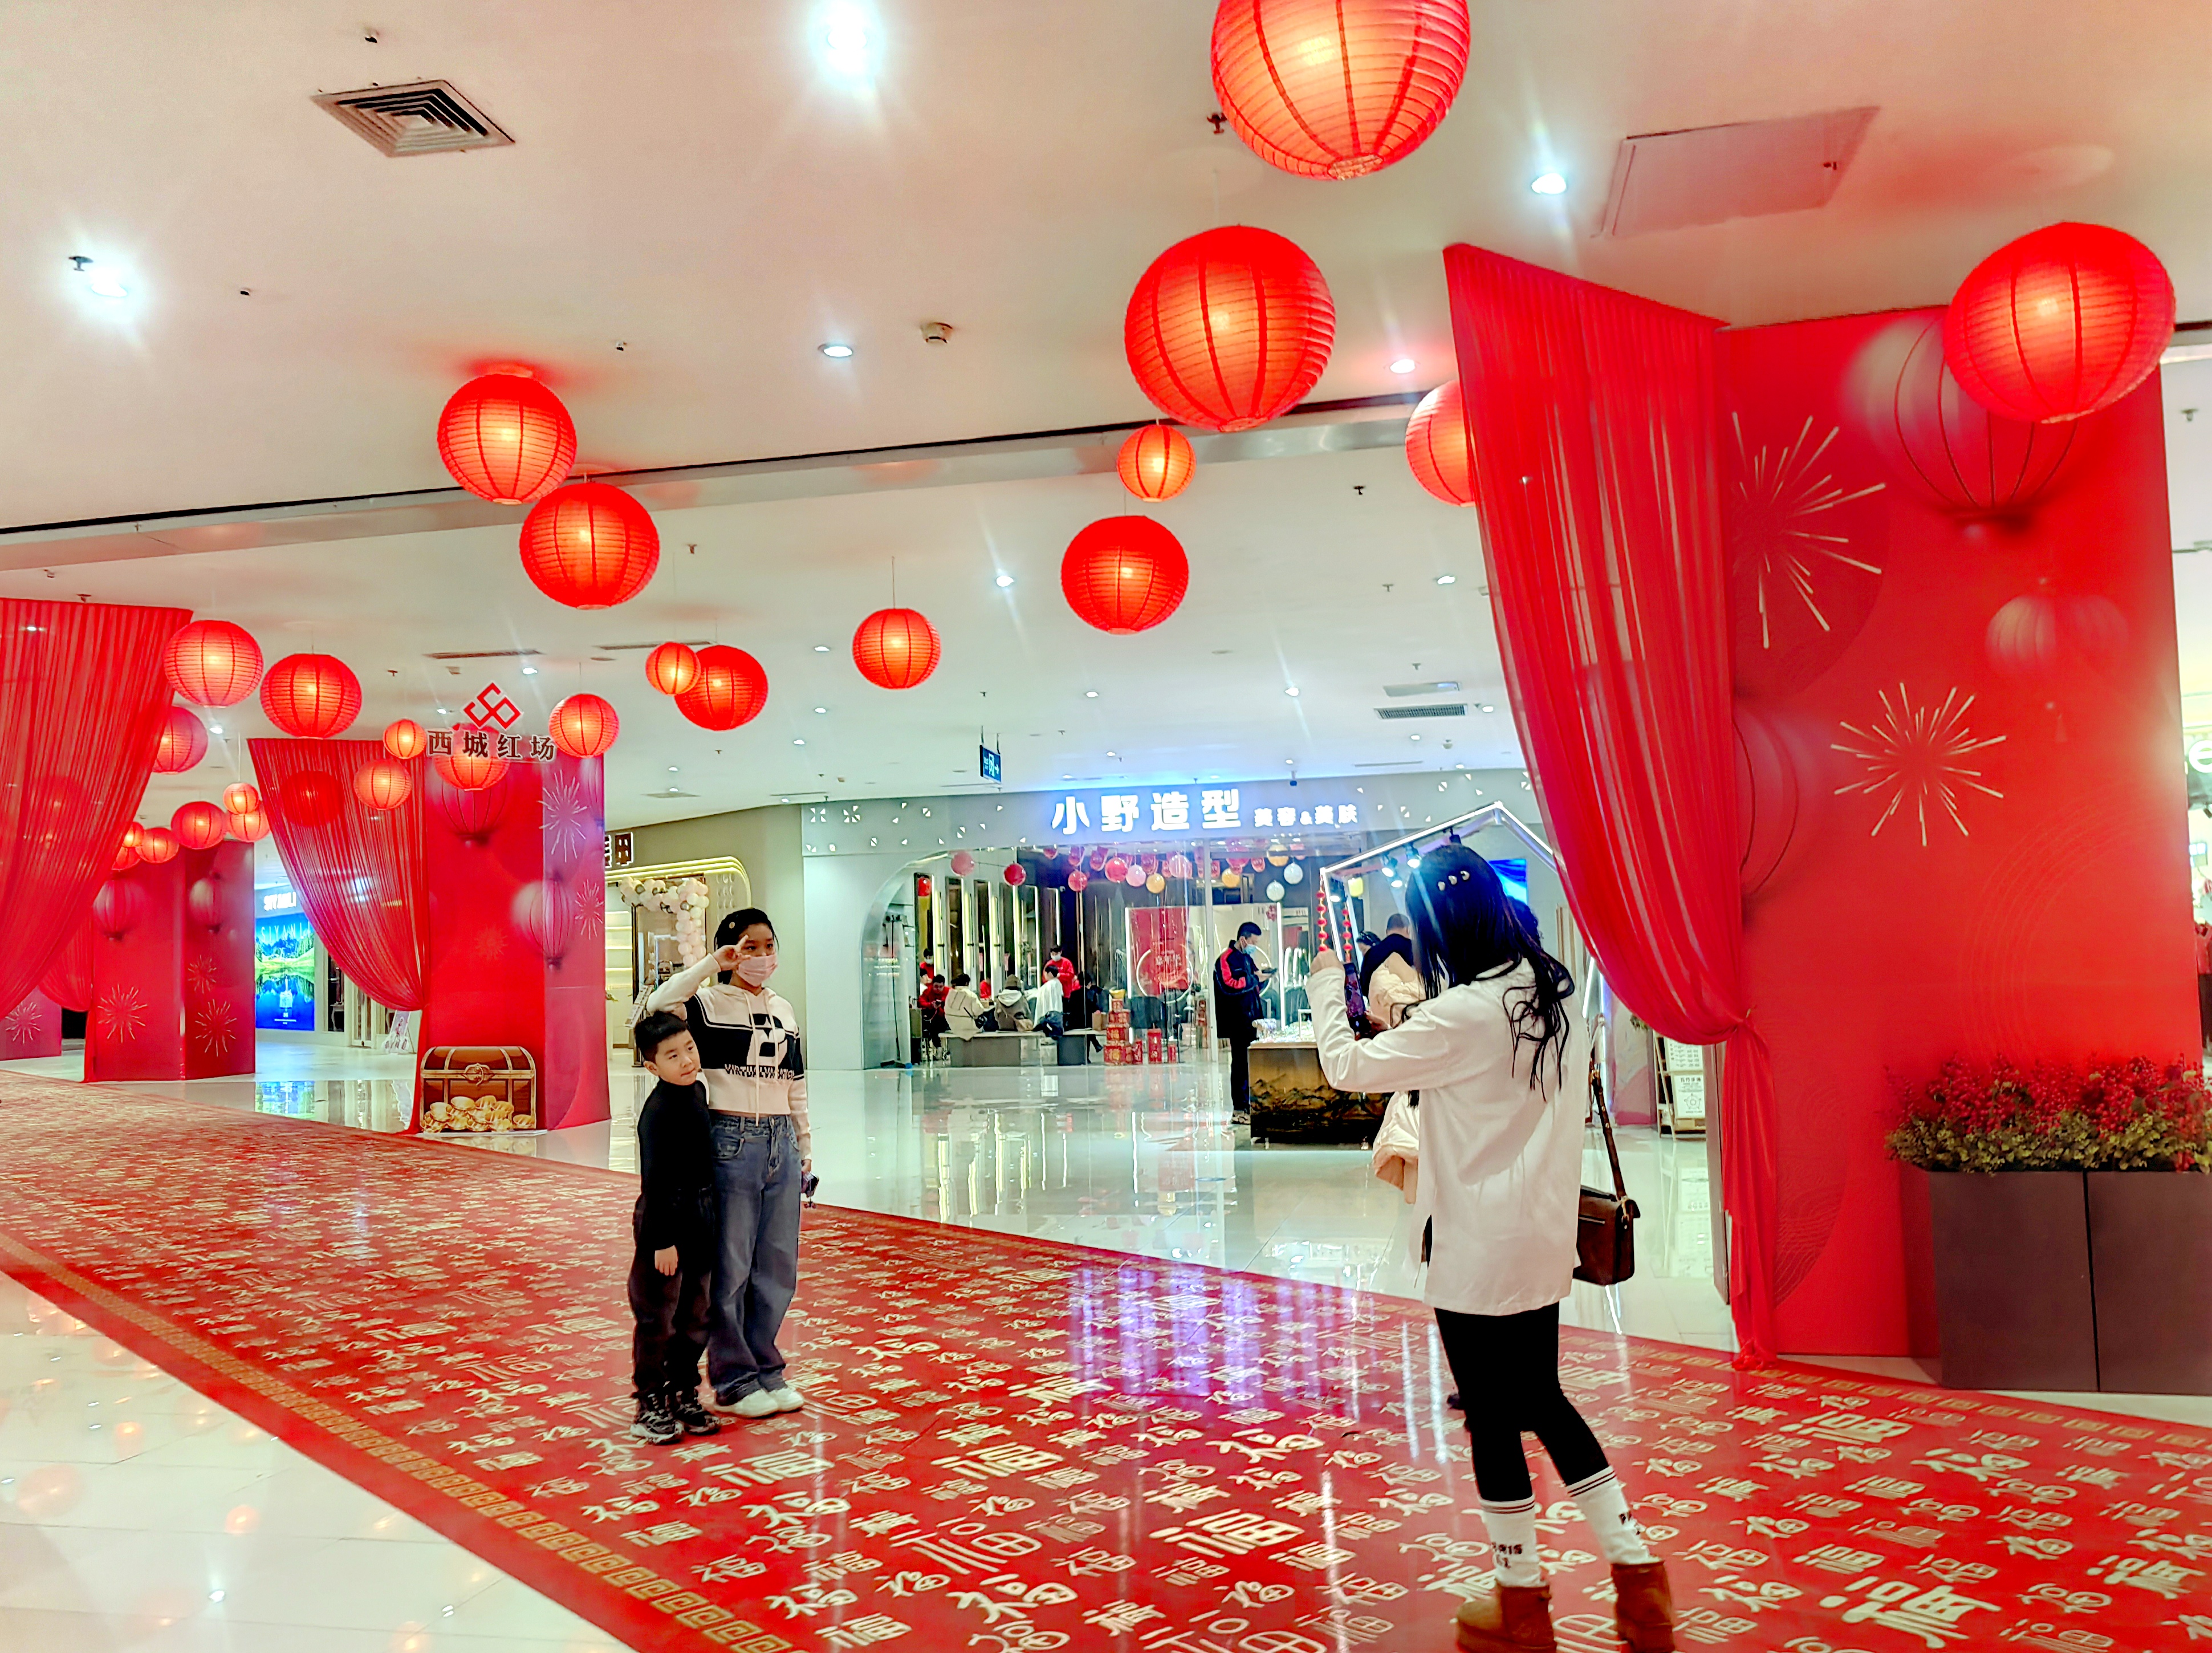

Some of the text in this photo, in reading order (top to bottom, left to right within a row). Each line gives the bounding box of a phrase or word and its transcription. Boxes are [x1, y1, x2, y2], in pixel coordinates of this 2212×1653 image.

[429, 730, 555, 761] 西城红场
[1051, 788, 1241, 835] 小野造型
